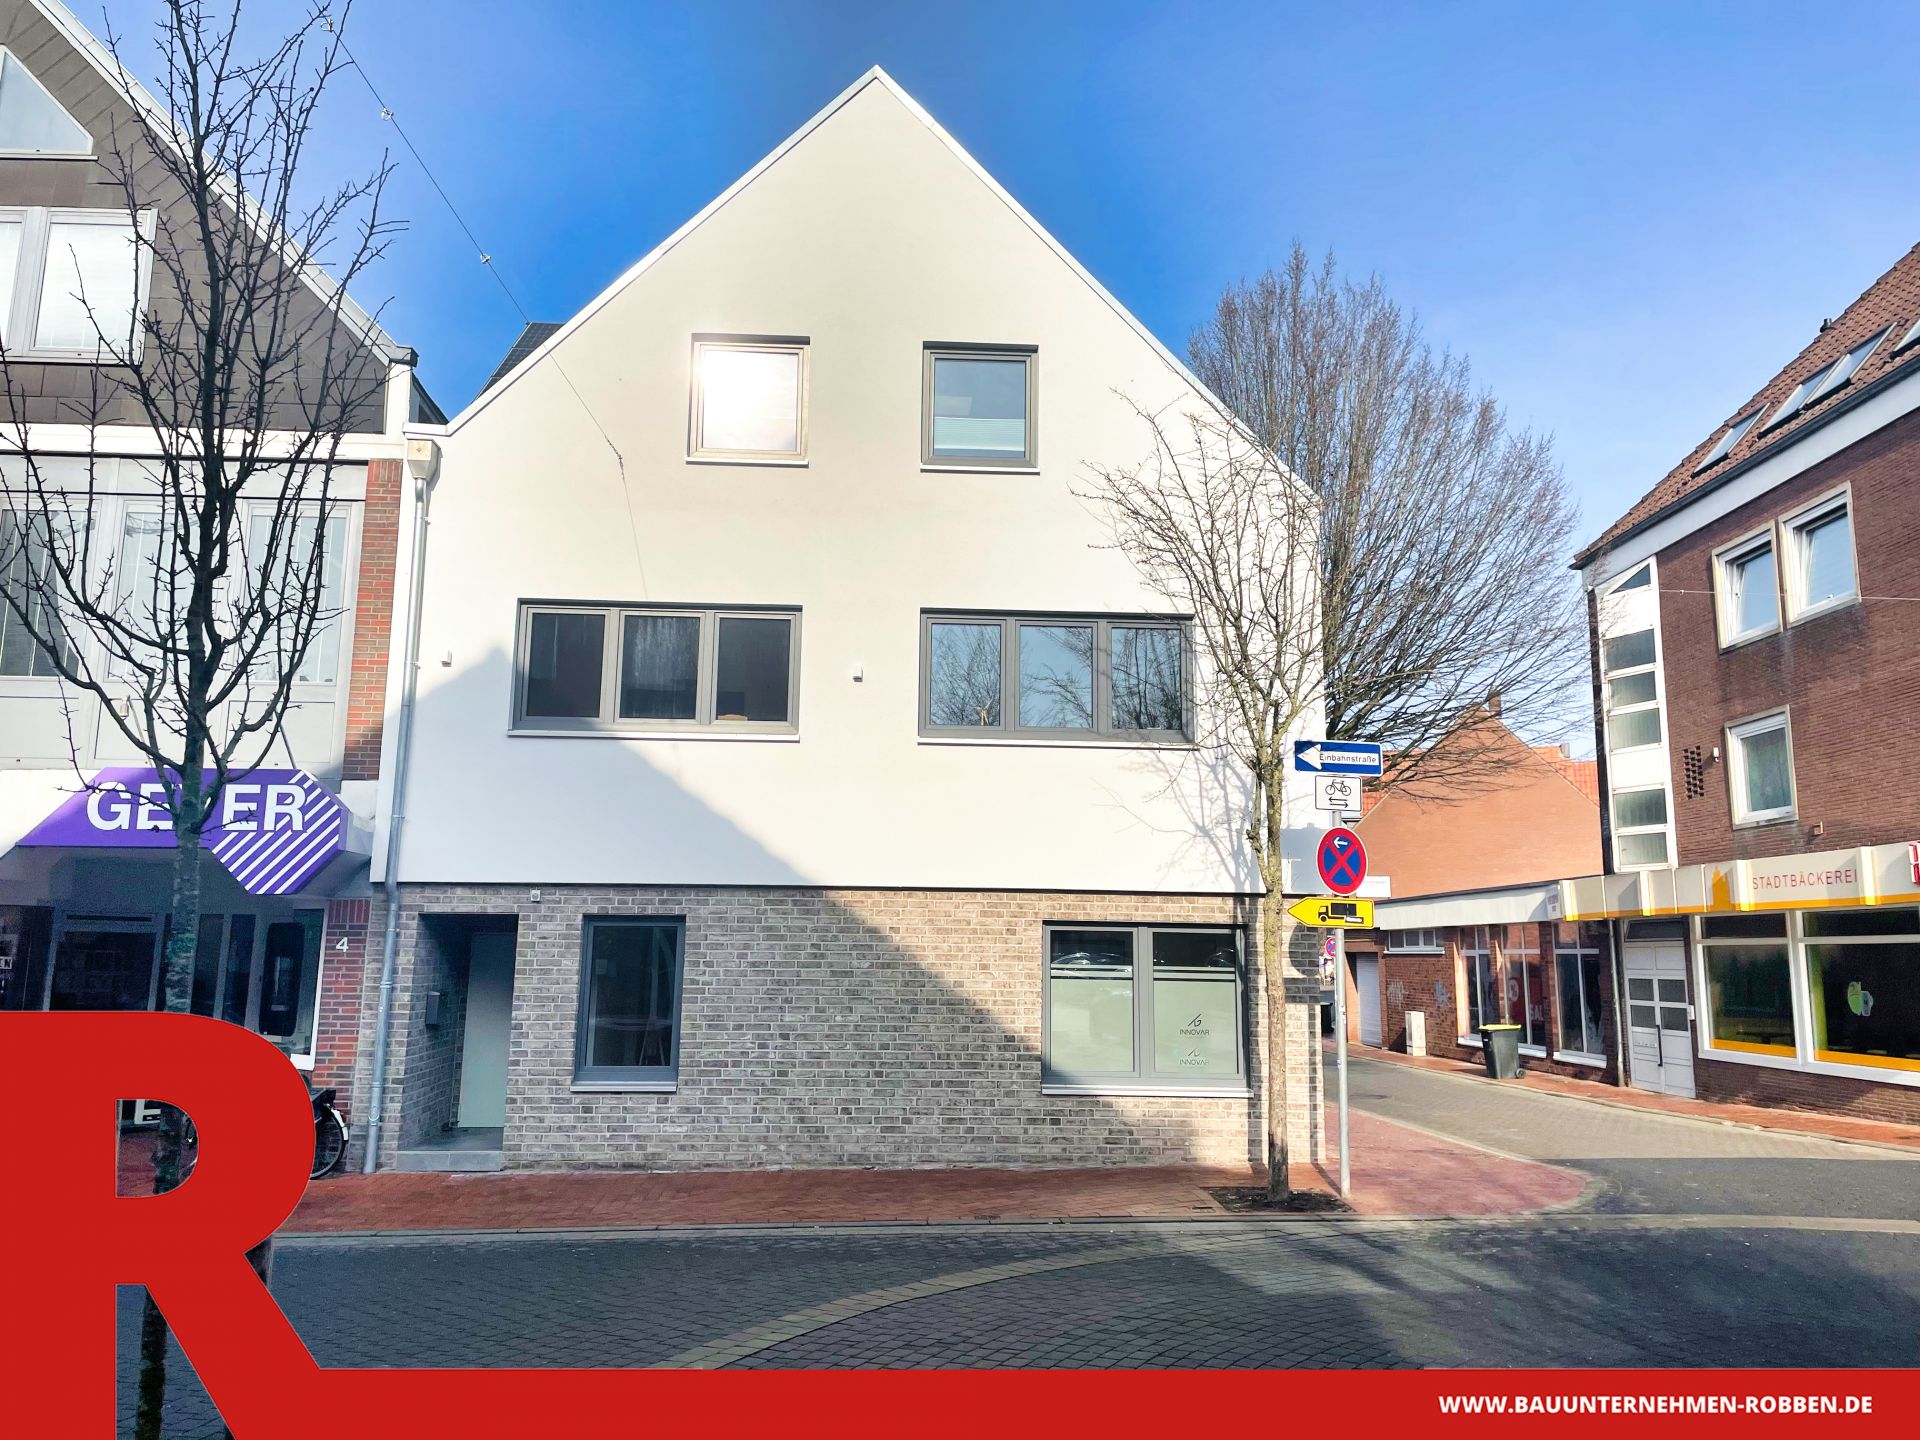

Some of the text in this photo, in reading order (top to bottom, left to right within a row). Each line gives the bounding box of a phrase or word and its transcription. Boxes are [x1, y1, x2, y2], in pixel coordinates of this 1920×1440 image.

[1320, 753, 1377, 764] Einbahnstraße
[86, 781, 307, 832] GEER
[1752, 868, 1858, 890] STADTBÄCKEREI
[335, 937, 349, 952] 4
